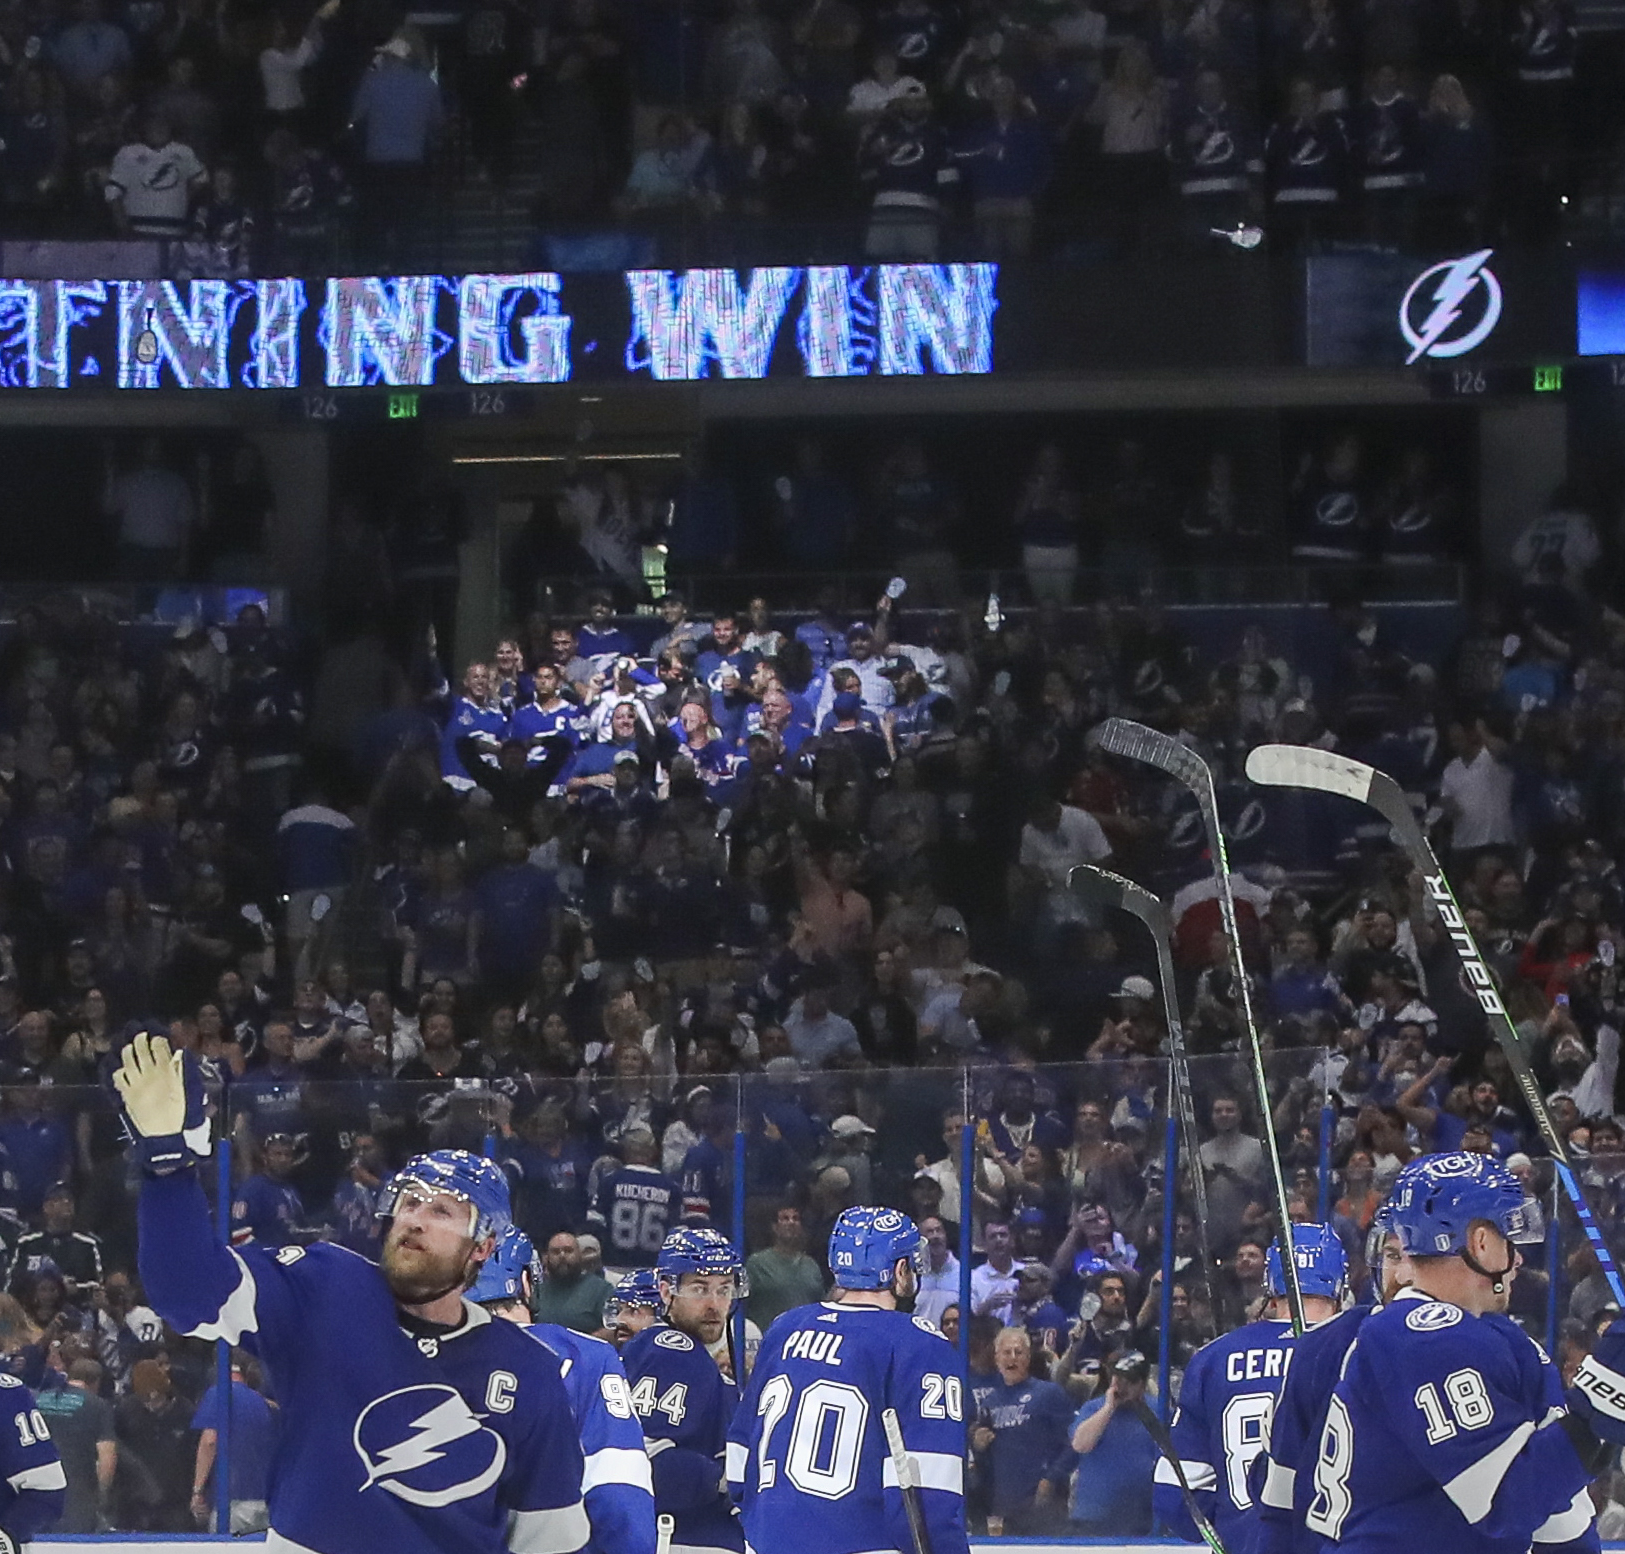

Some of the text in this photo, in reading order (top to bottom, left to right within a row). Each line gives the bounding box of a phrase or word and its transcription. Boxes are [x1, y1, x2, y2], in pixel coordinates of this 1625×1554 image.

[625, 262, 999, 381] WIN
[1424, 874, 1506, 1016] BAUER
[1430, 1153, 1477, 1174] TGH
[611, 1200, 668, 1250] 86
[837, 1251, 852, 1267] 20
[782, 1329, 844, 1366] PAUL
[1227, 1347, 1295, 1383] CER
[485, 1370, 518, 1414] C
[600, 1374, 633, 1419] 9
[629, 1376, 688, 1427] 44
[921, 1373, 963, 1422] 20
[1415, 1367, 1495, 1446] 18
[14, 1408, 52, 1447] 10
[756, 1373, 871, 1501] 20
[1222, 1391, 1275, 1512] 8
